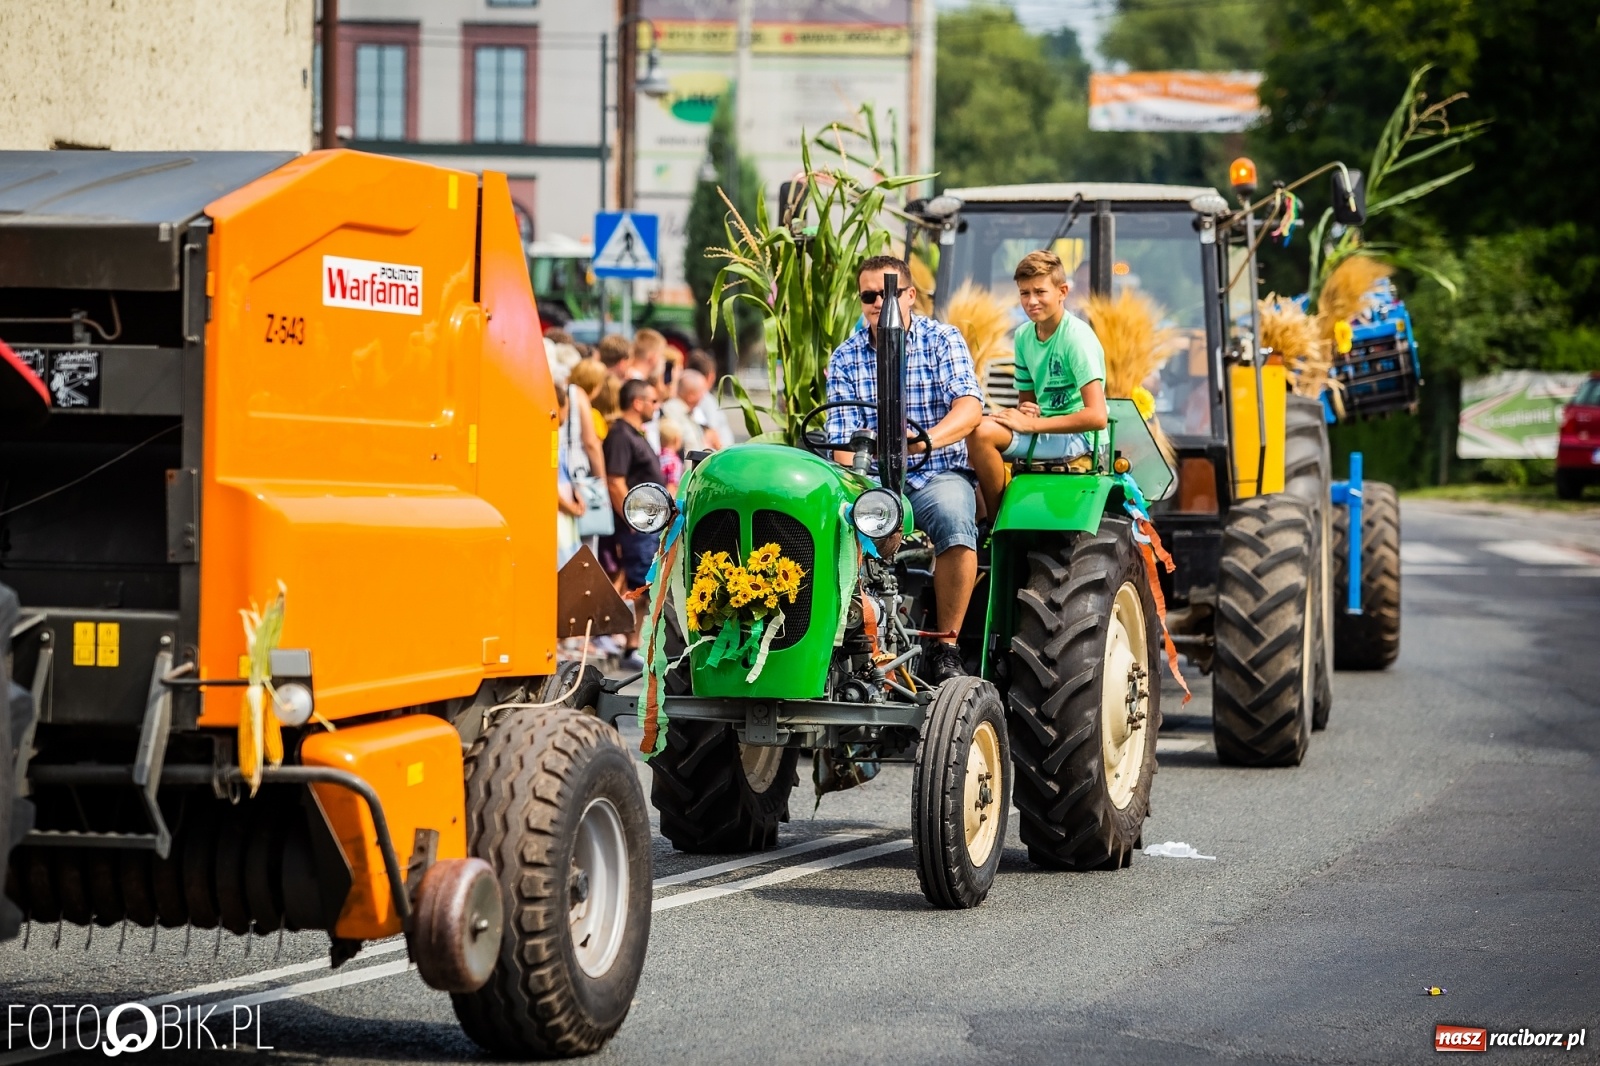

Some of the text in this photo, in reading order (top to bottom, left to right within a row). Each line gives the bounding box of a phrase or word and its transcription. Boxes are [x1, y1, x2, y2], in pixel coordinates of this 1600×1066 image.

[327, 267, 419, 308] Warfama
[380, 267, 419, 283] POLMOT
[264, 313, 305, 346] Z-543
